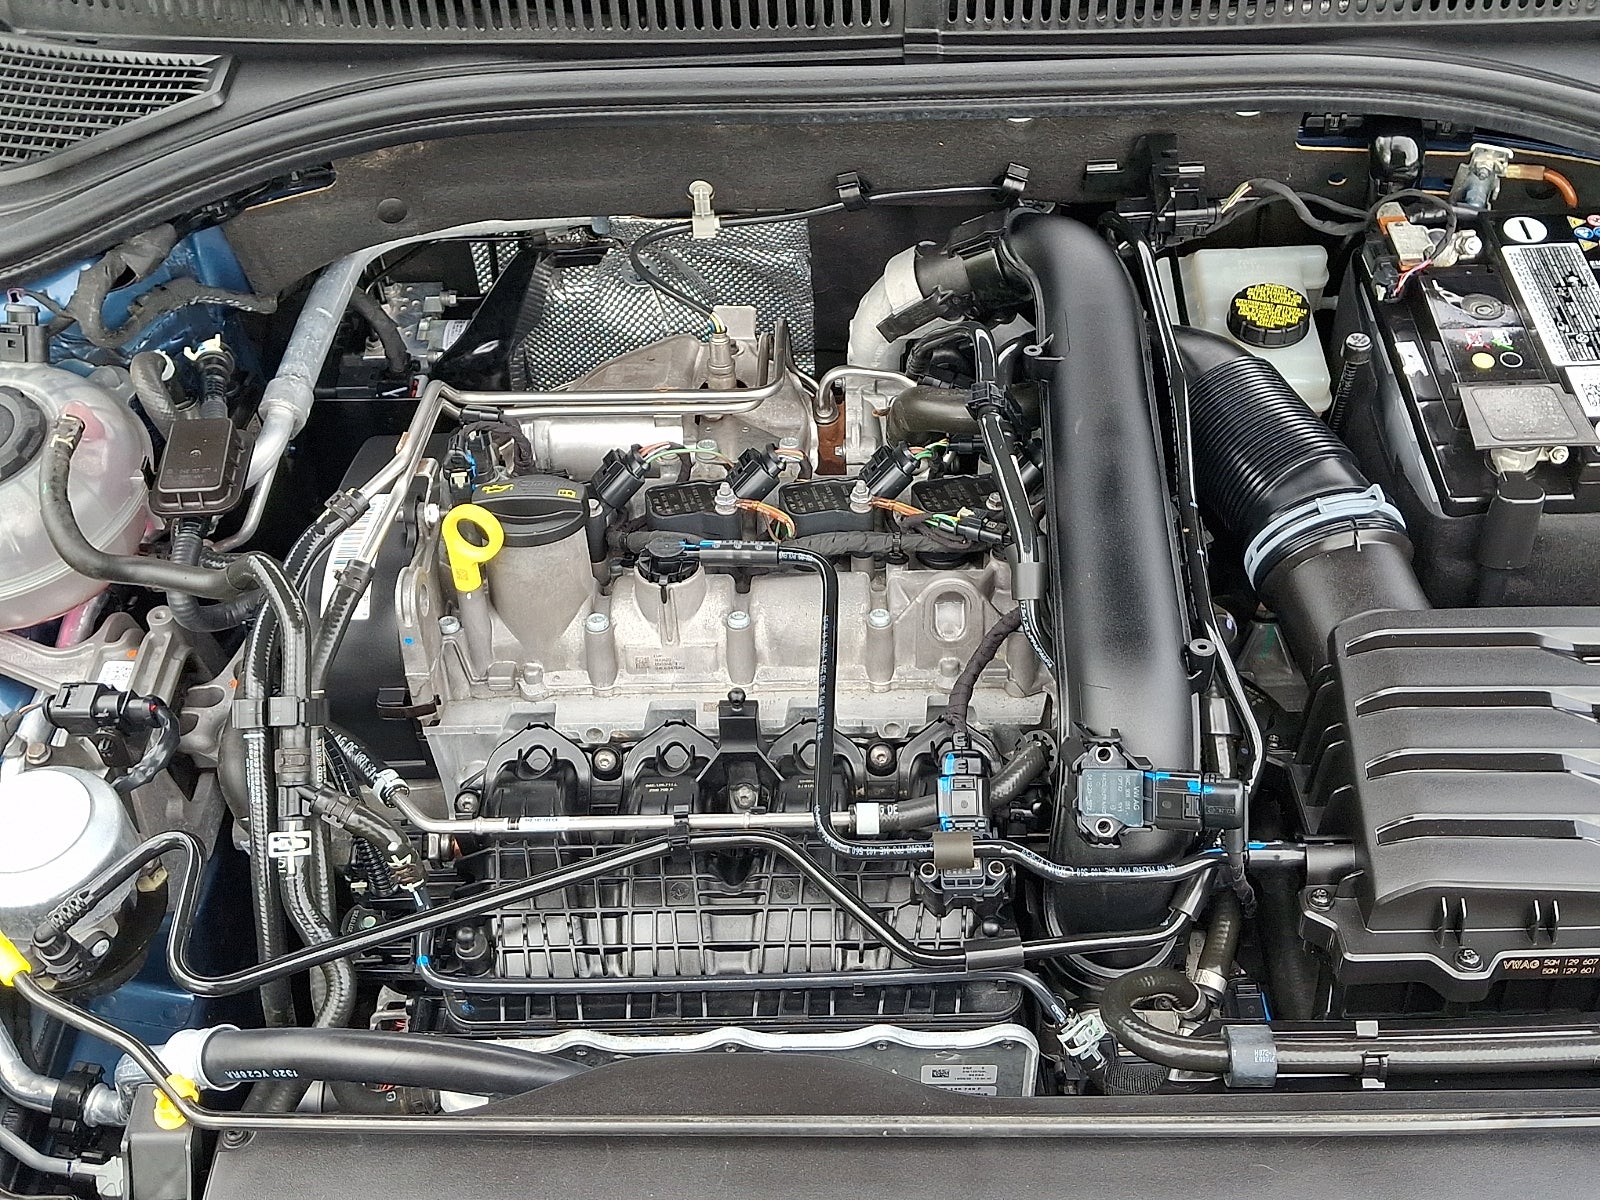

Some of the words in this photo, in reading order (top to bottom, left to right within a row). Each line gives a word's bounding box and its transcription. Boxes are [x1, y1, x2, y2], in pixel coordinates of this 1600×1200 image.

[1564, 958, 1580, 966] 129
[1582, 958, 1599, 966] 607
[1563, 967, 1578, 975] 129
[272, 1069, 299, 1078] 1320
